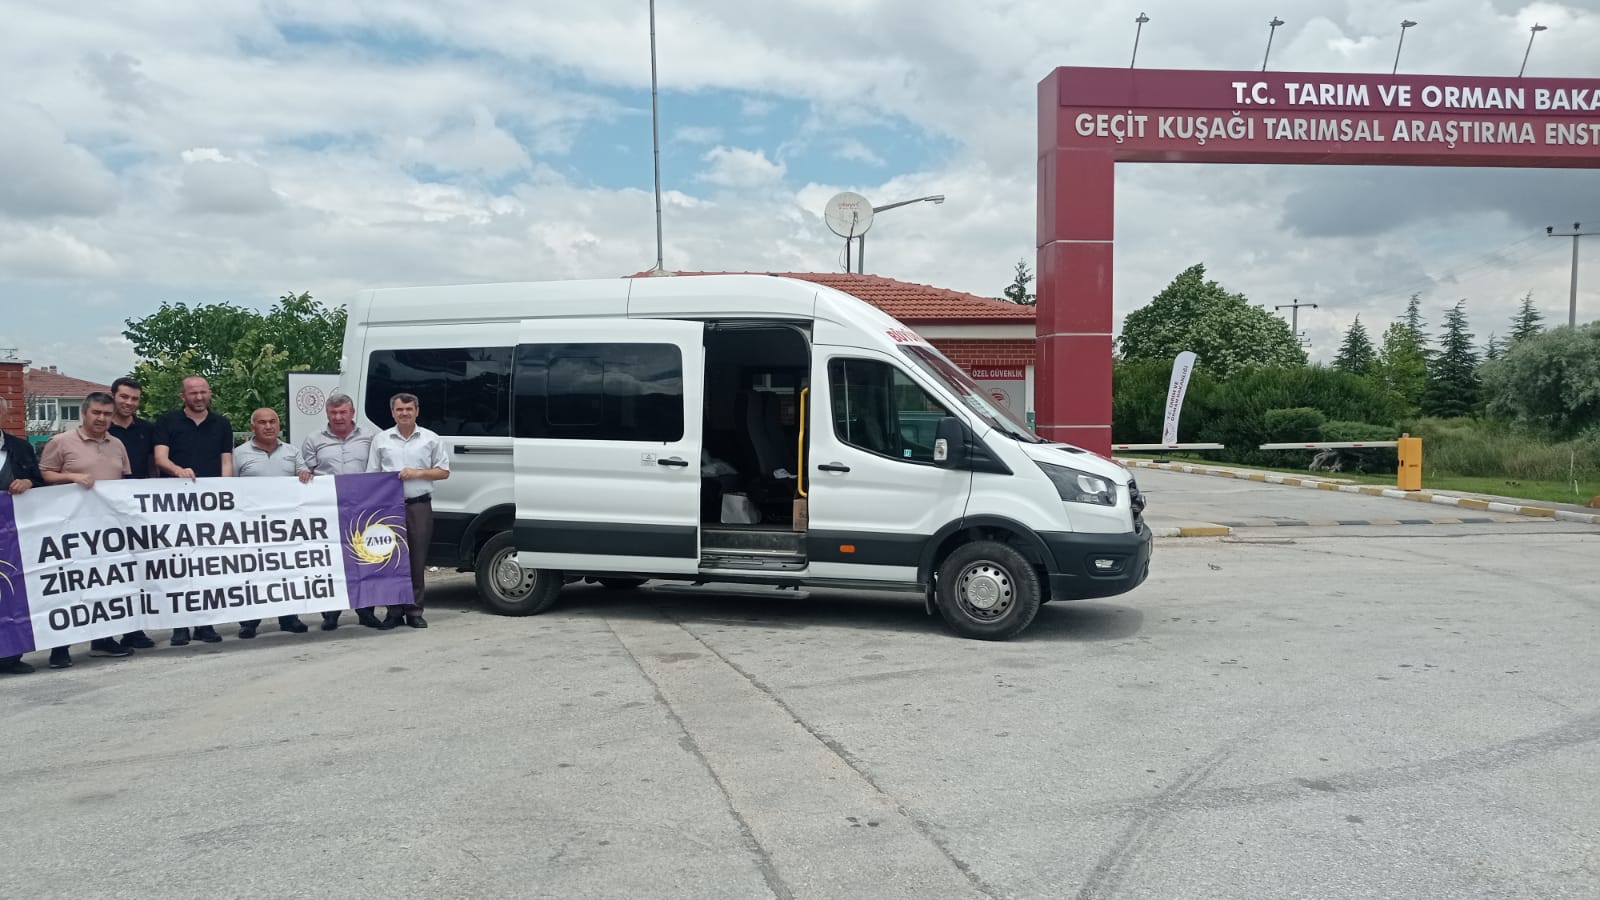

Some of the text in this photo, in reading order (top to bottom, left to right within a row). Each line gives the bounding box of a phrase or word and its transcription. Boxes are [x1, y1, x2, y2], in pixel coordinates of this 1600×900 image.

[1231, 81, 1276, 105] T.C.
[1284, 82, 1370, 106] TARIM
[1377, 84, 1411, 107] VE
[1421, 85, 1525, 110] ORMAN
[1075, 109, 1600, 149] GEÇİT KUŞAĞI TARIMSAL ARAŞTIRMA ENST
[972, 368, 989, 378] ÖZEL
[133, 491, 235, 513] TMMOB
[38, 514, 329, 563] AFYONKARAHİSAR
[366, 535, 392, 547] ZMO
[40, 544, 332, 596] ZİRAAT MÜHENDİSLERİ
[48, 573, 335, 631] ODASI İL TEMSİLCİLİĞİ
